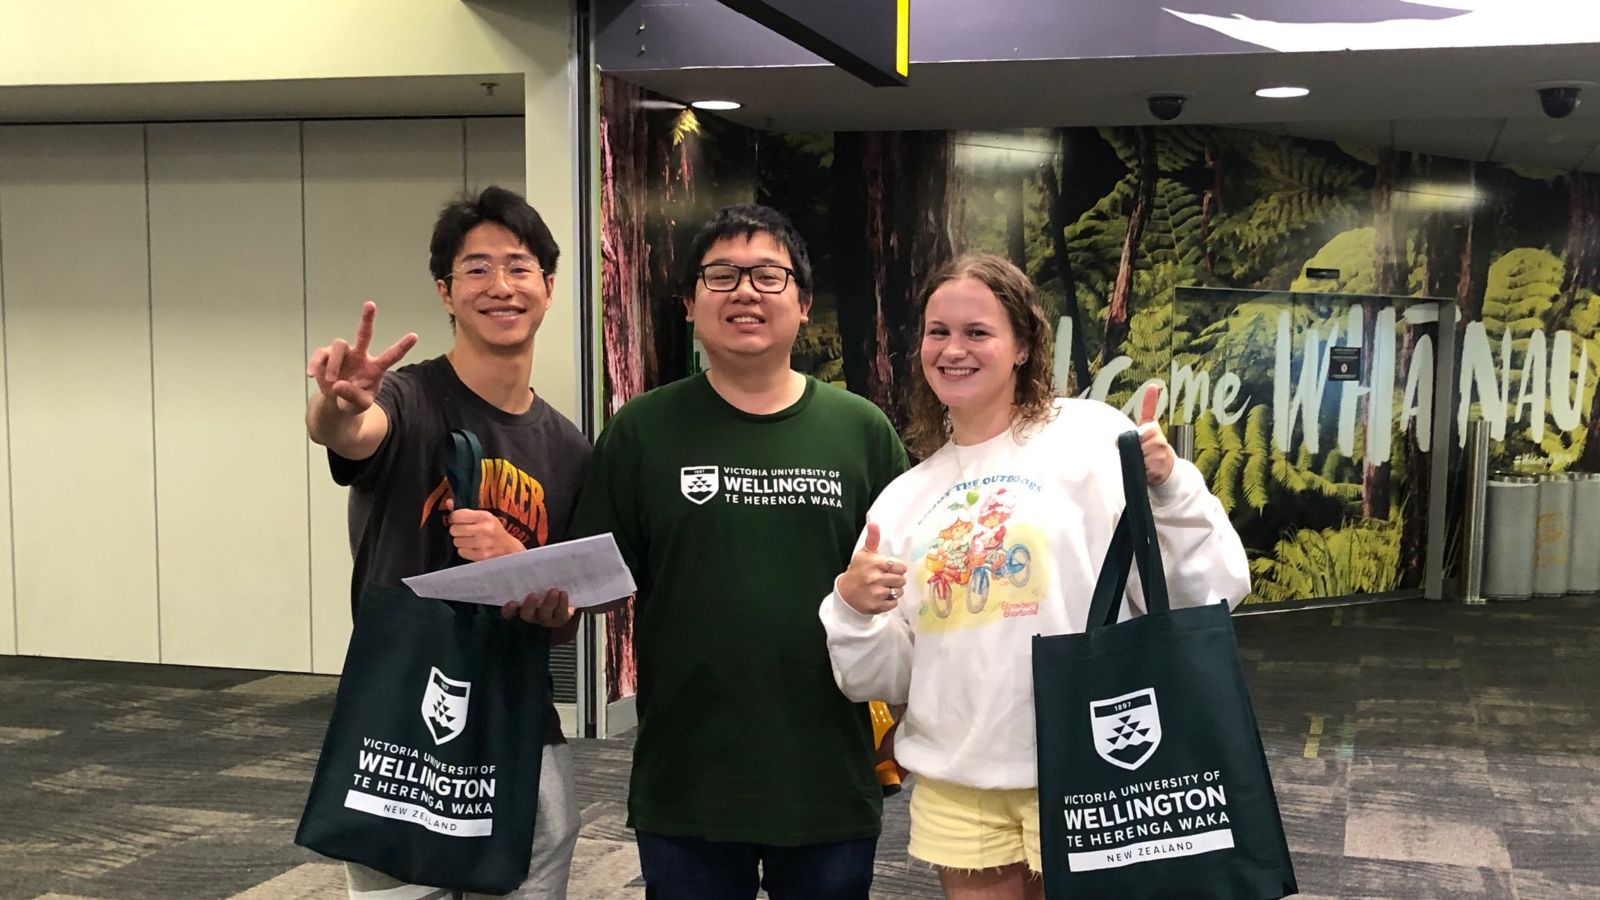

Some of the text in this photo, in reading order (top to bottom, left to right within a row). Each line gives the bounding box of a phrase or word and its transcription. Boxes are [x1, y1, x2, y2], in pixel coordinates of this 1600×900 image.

[723, 466, 841, 478] VICTORIA UNIVERSITY OF
[723, 476, 843, 497] WELLINGTON
[724, 493, 843, 509] TE HERENGA WAKA
[1114, 701, 1132, 712] 1897
[363, 737, 497, 776] VICTORIA UNIVERSITY OF
[358, 750, 496, 799] WELLINGTON
[1064, 770, 1221, 805] VICTORIA UNIVERSITY OF
[353, 773, 494, 815] TE HERENGA WAKA
[1064, 784, 1227, 831] WELLINGTON
[383, 804, 408, 815] NEW
[1066, 811, 1230, 848] TE HERENGA WAKA
[1106, 841, 1194, 863] NEW ZEALAND
